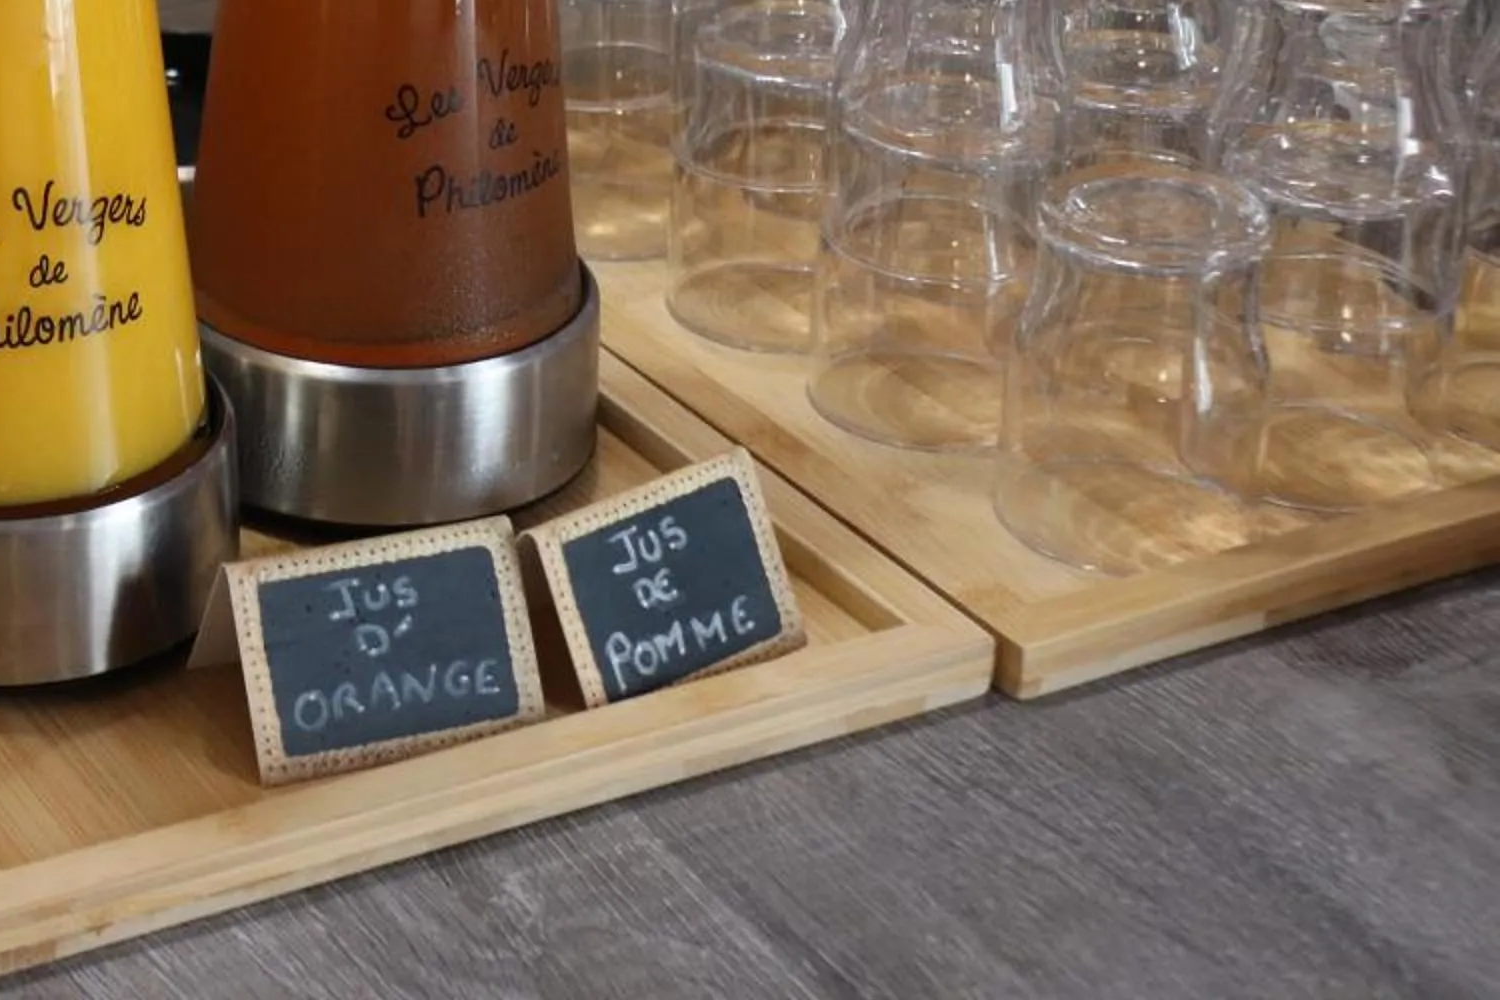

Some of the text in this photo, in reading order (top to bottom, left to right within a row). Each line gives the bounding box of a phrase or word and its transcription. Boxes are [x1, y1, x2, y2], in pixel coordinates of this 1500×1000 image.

[489, 118, 518, 150] de
[13, 180, 147, 245] Vergers
[29, 254, 68, 288] de
[607, 515, 688, 574] JUS
[324, 576, 419, 620] JUS
[632, 567, 678, 609] DE
[355, 614, 413, 657] D'
[604, 594, 756, 694] POMME
[293, 659, 501, 731] ORANGE
